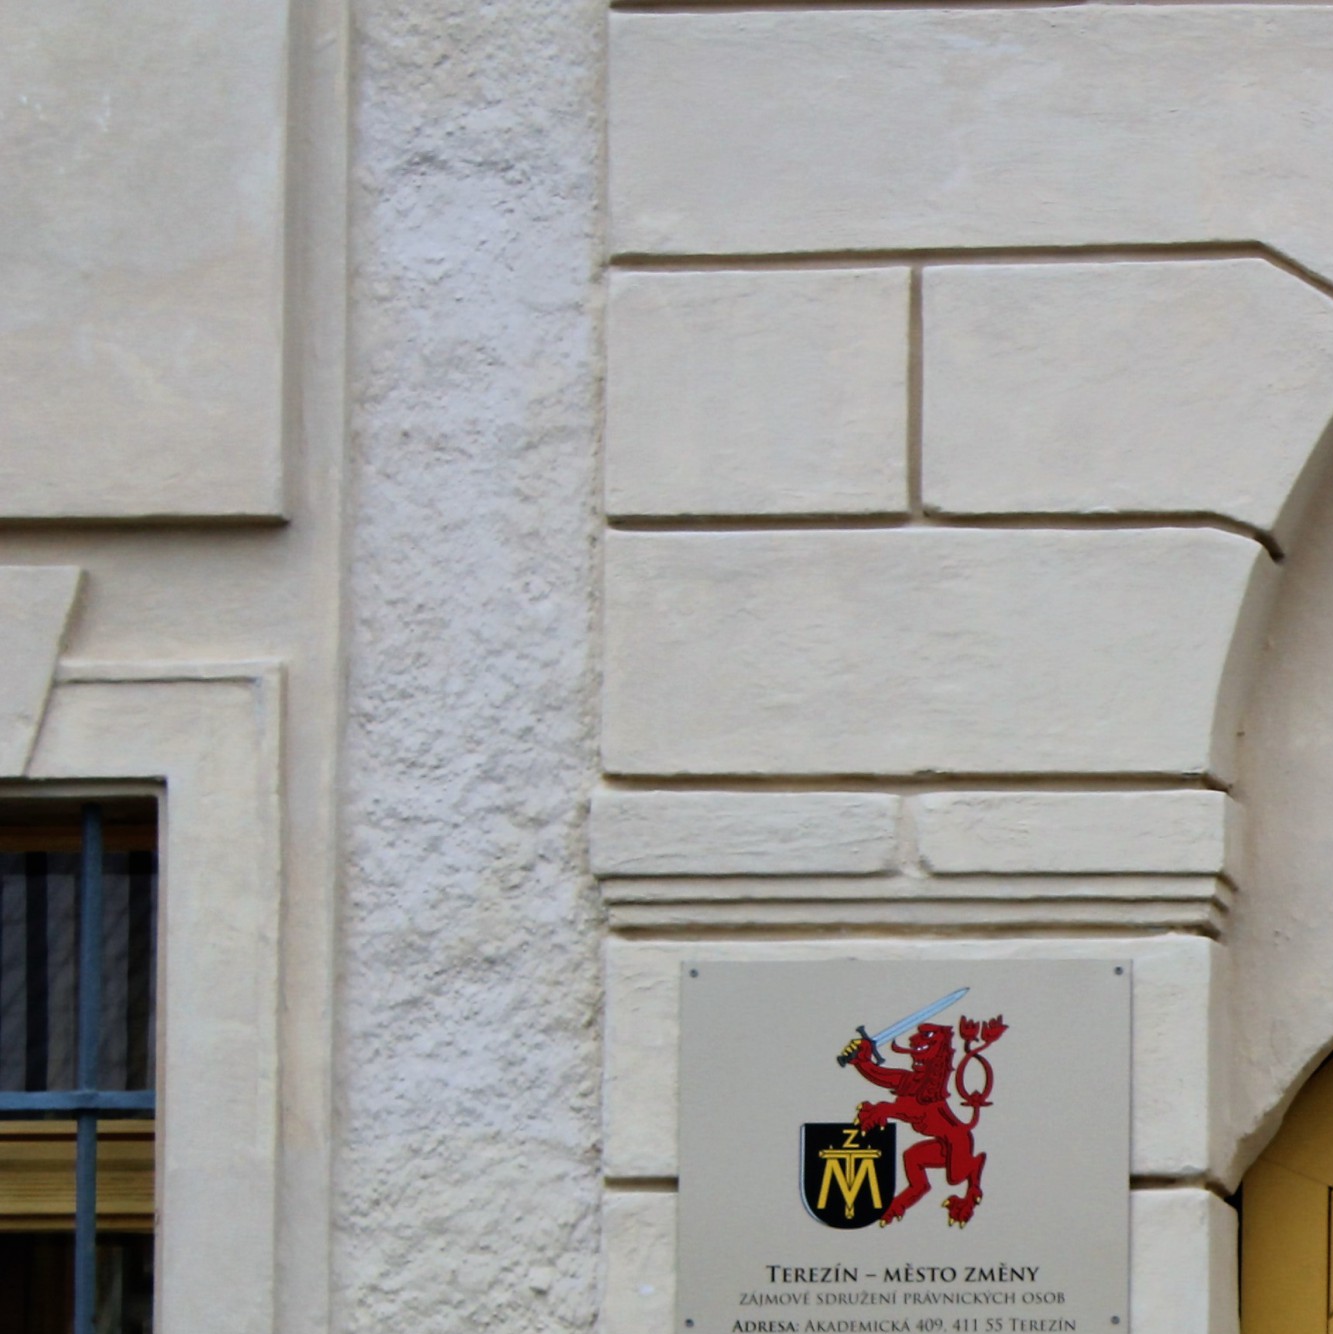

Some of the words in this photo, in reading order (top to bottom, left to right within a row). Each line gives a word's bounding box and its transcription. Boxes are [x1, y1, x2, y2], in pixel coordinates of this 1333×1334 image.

[738, 1290, 810, 1308] ZÁJMOVÉ
[815, 1289, 897, 1306] SDRUŽENÍ
[902, 1288, 1016, 1306] PRÁVNICKÝCH
[1020, 1291, 1066, 1305] OSOB
[951, 1317, 978, 1333] 411
[985, 1317, 1004, 1333] 55
